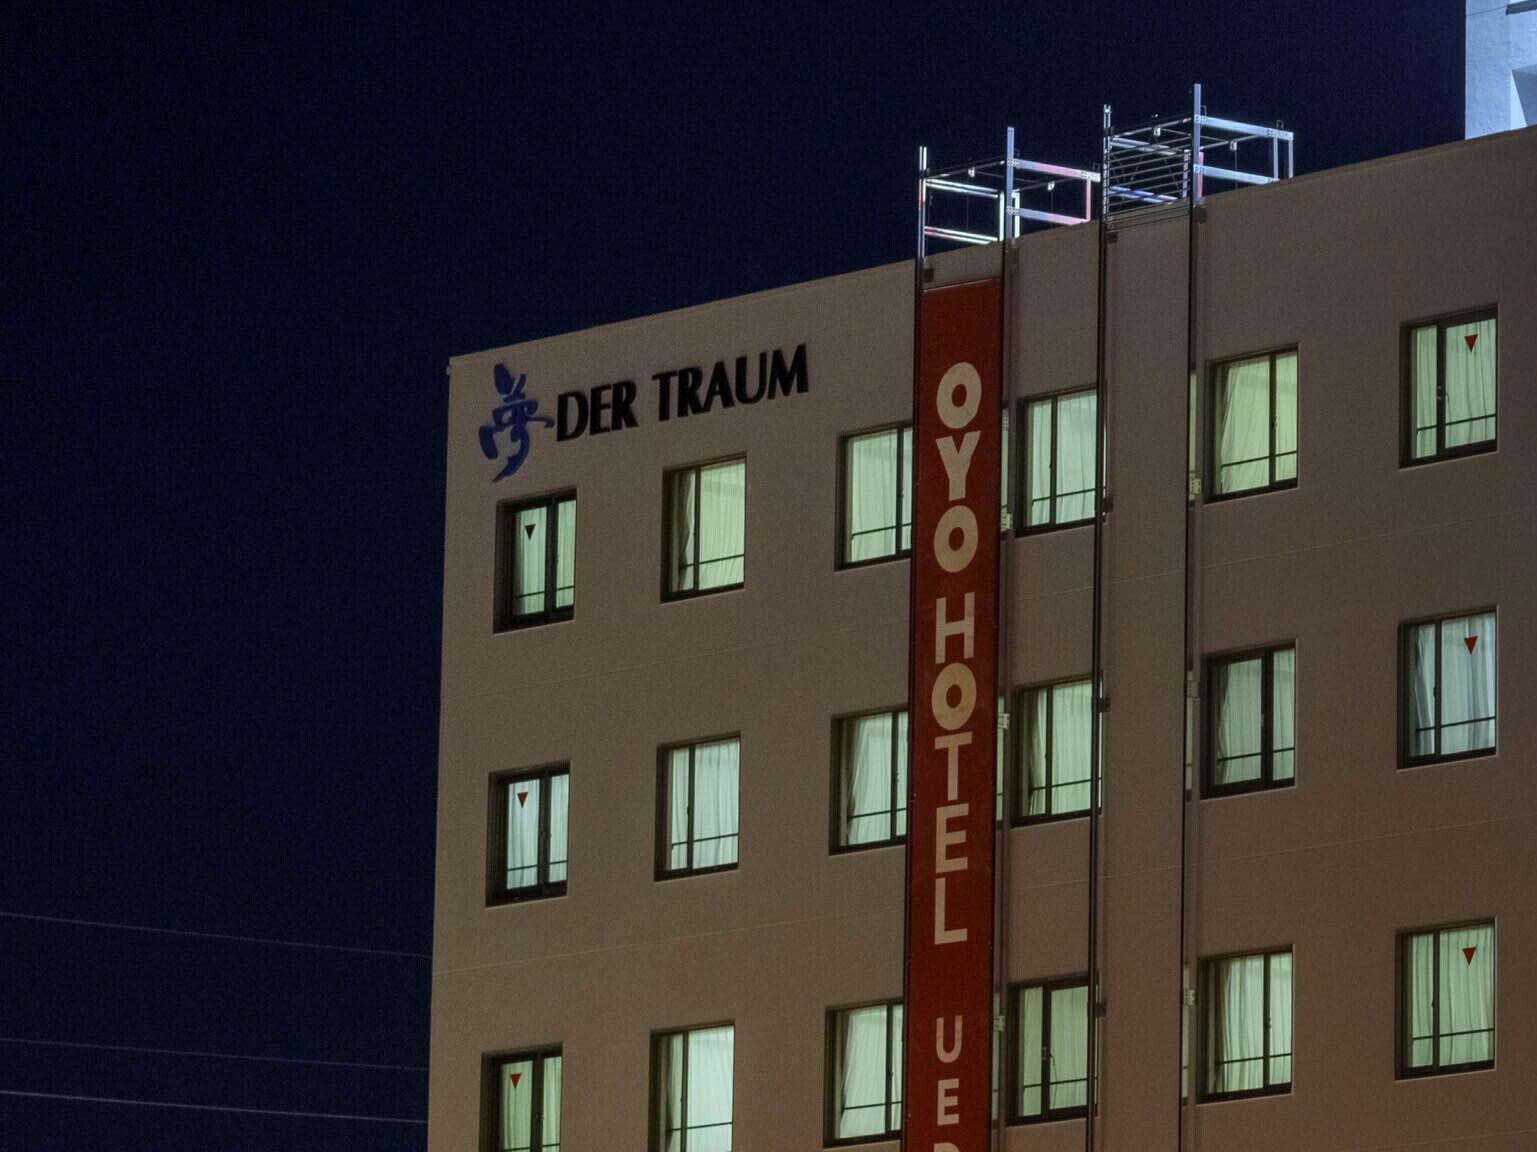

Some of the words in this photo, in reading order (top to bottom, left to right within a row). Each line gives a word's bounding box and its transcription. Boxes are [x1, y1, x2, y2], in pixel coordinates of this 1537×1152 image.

[556, 379, 639, 442] DER
[652, 343, 809, 422] TRAUM
[932, 361, 983, 574] OYO
[931, 592, 977, 945] HOTEL
[932, 1014, 963, 1152] UE
